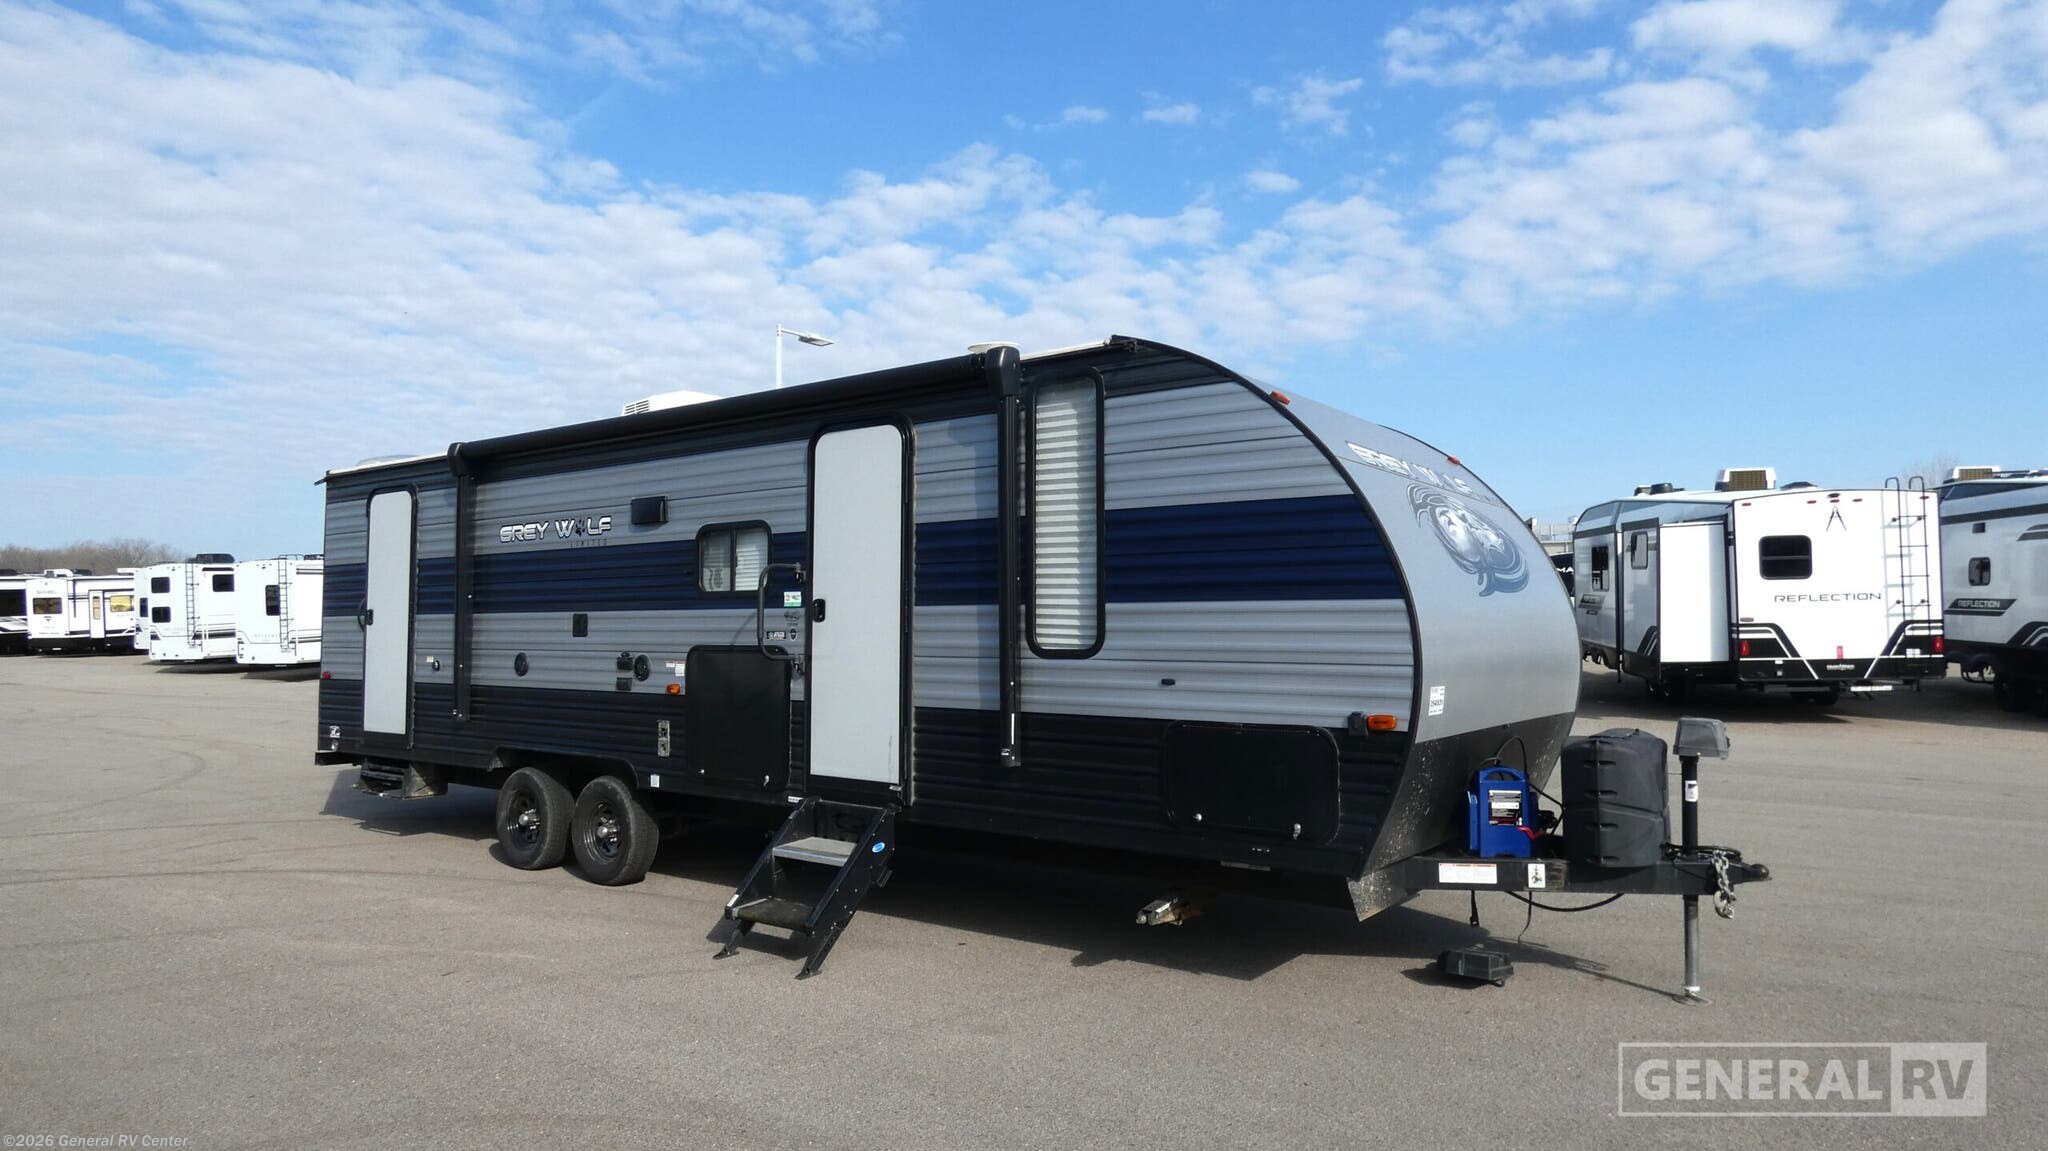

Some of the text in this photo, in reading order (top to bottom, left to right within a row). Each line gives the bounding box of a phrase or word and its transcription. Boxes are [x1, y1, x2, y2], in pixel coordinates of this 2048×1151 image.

[500, 521, 549, 543] GREY
[1774, 592, 1881, 604] REFLECTION
[1957, 599, 2000, 608] REFLECTION
